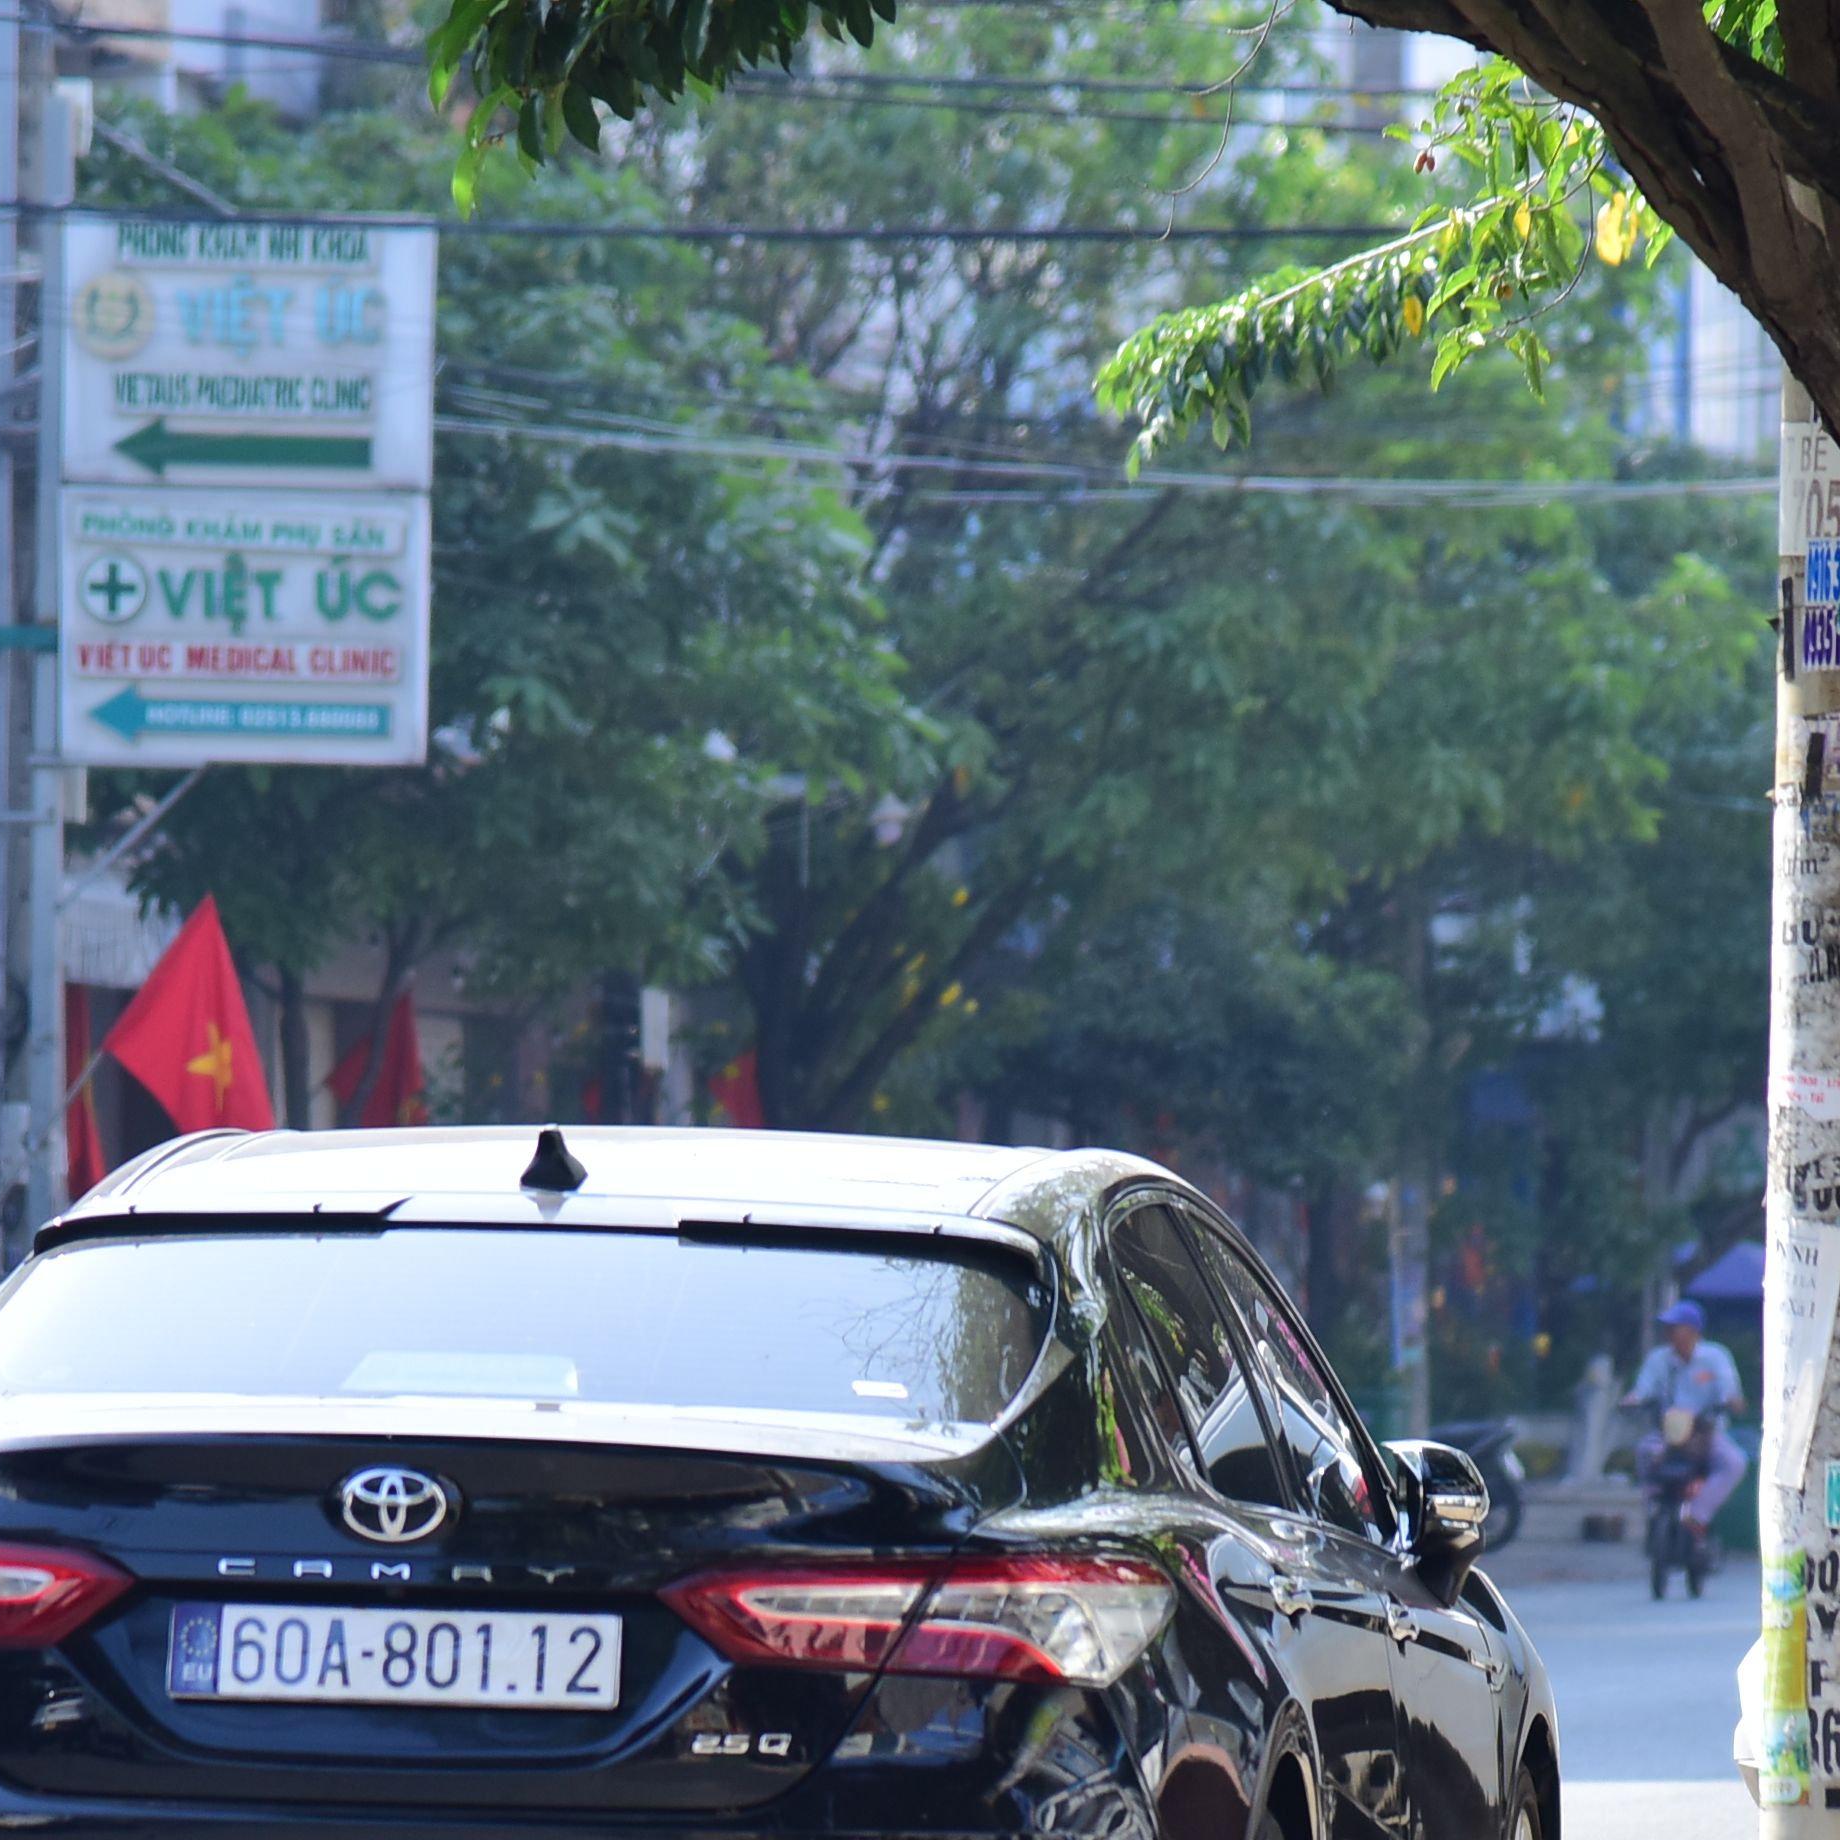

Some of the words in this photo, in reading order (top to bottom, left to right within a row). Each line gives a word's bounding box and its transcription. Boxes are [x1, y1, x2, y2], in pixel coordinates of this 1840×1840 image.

[177, 274, 292, 358] VIỆT
[315, 275, 389, 347] ÚC
[158, 550, 283, 635] VIỆT
[315, 554, 402, 623] ÚC
[185, 644, 297, 675] MEDICAL
[309, 646, 397, 677] CLINIC
[218, 1557, 575, 1584] CAMRY
[181, 1662, 214, 1686] EU
[230, 1615, 603, 1695] 60A-801.12
